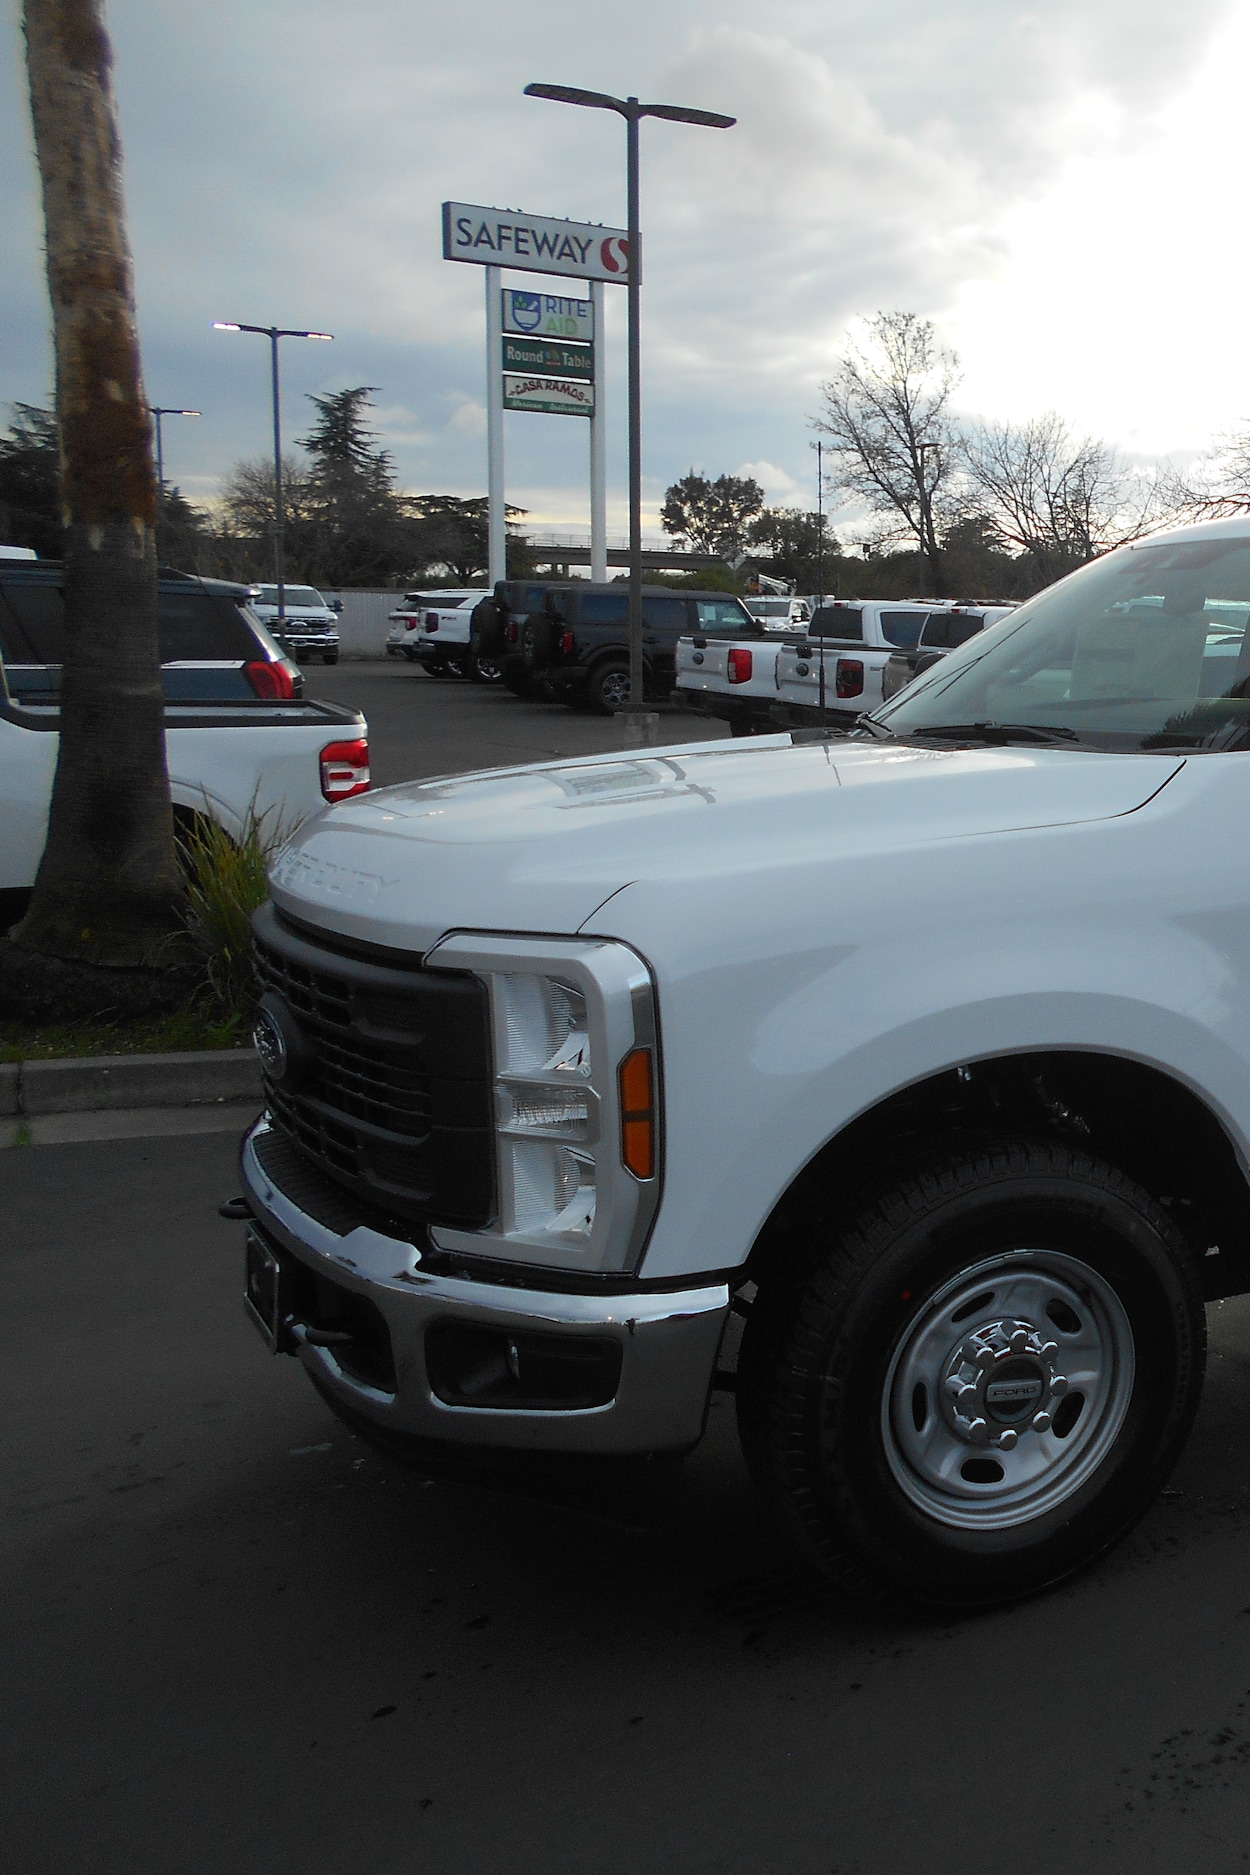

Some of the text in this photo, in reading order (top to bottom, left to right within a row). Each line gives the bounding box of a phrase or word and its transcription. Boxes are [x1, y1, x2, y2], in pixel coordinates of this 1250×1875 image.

[456, 218, 594, 264] SAFEWAY
[546, 296, 587, 318] RITE
[546, 316, 578, 335] AID
[506, 345, 592, 369] Round Table
[515, 380, 585, 402] CASA RAMOS
[993, 1386, 1036, 1396] FORD
